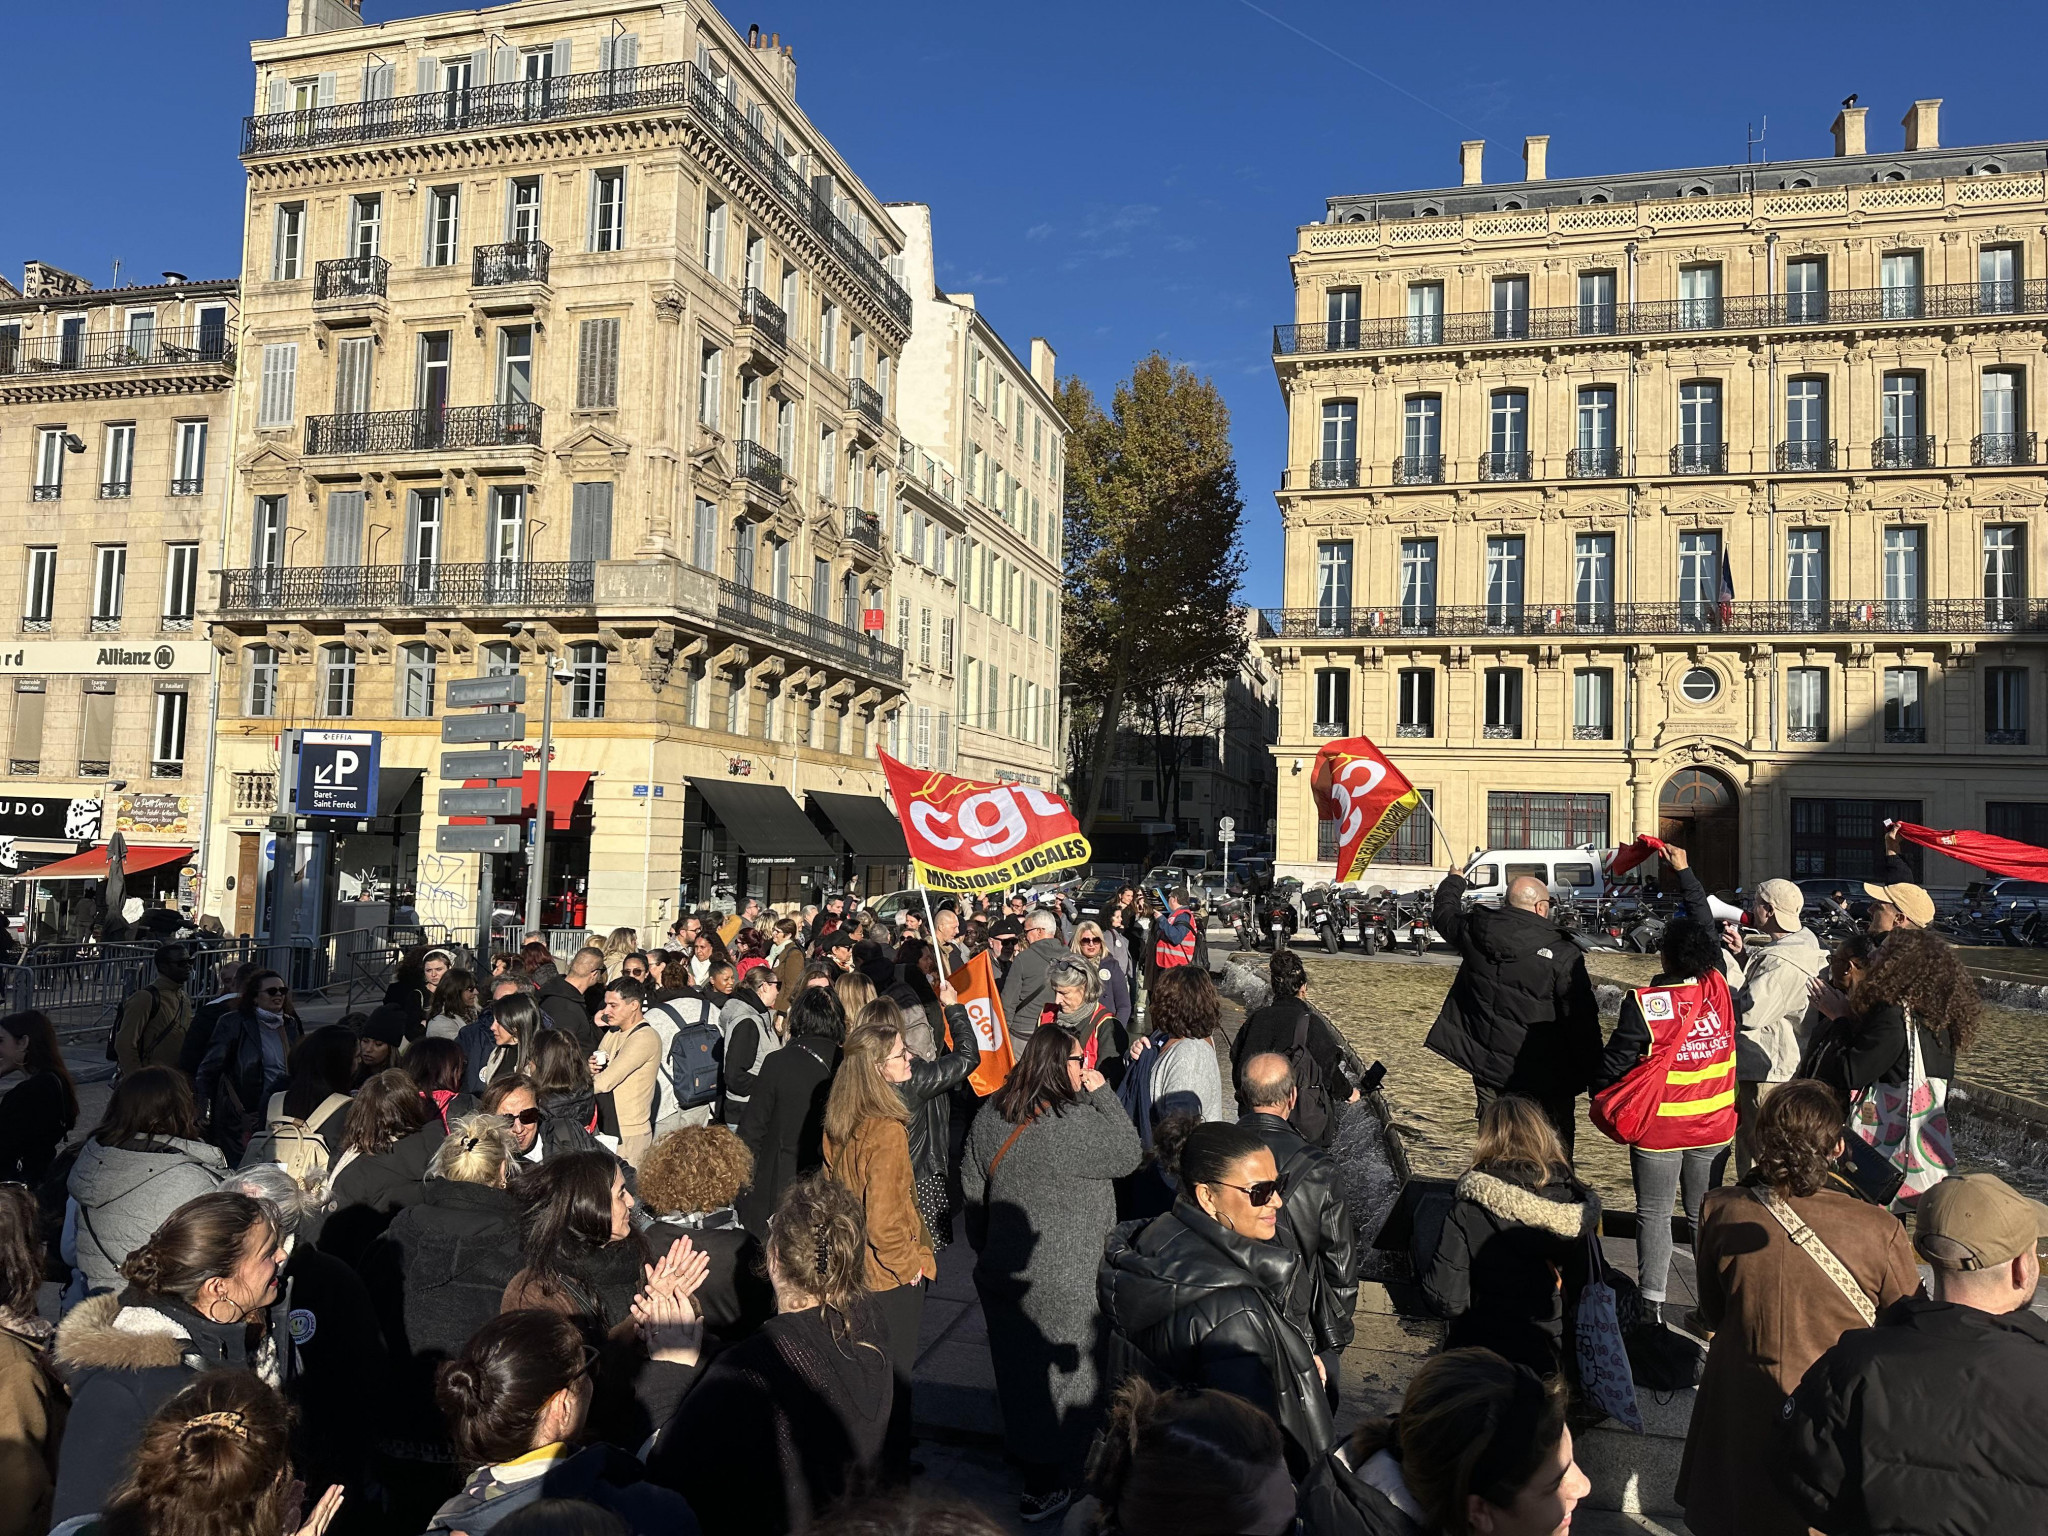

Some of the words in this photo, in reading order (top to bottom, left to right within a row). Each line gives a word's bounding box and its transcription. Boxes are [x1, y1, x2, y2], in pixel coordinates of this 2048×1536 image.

[0, 650, 24, 666] rd
[97, 648, 151, 665] Allianz
[335, 750, 359, 785] P
[313, 800, 331, 808] Saint
[925, 868, 1012, 890] MISSIONS
[1011, 839, 1087, 877] LOCALES
[1676, 1052, 1689, 1062] DE
